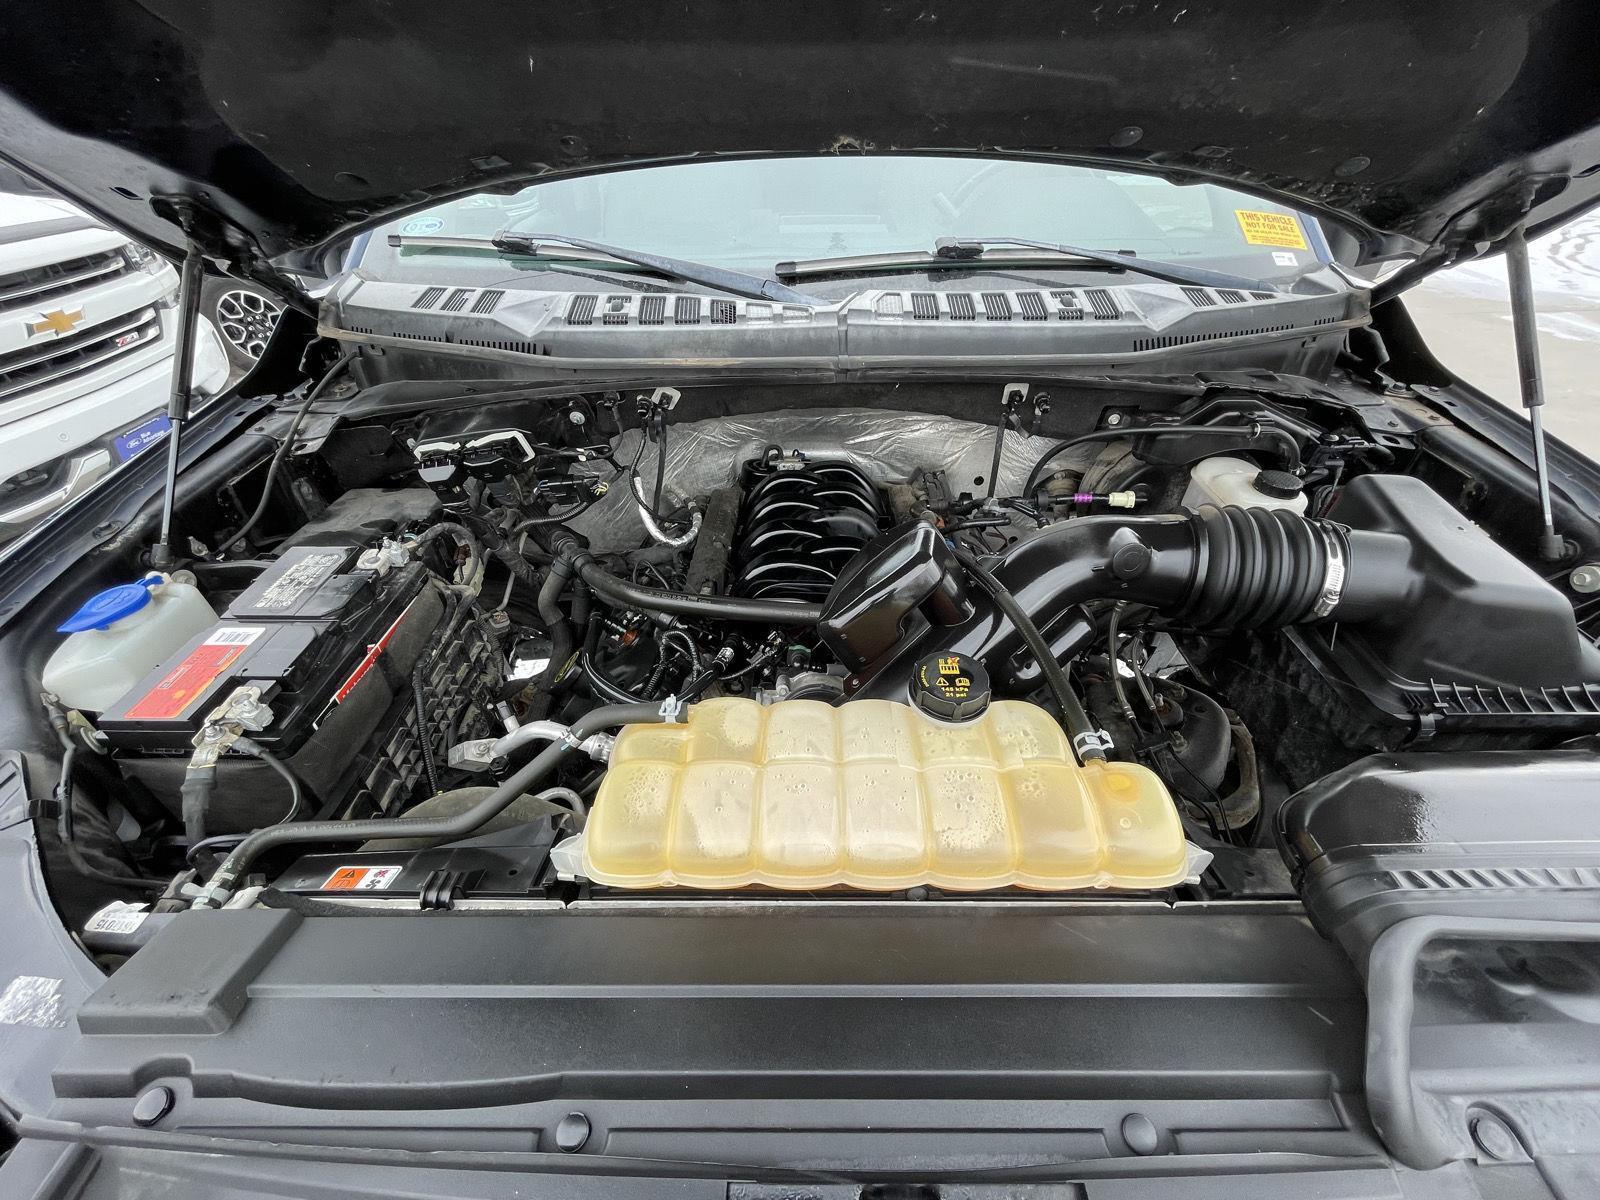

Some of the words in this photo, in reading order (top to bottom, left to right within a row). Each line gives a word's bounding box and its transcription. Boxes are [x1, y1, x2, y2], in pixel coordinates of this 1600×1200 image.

[1240, 212, 1261, 222] THIS
[1260, 214, 1295, 226] VEHICLE
[1245, 221, 1261, 229] NOT
[1262, 222, 1277, 231] FOR
[1278, 225, 1296, 233] SALE
